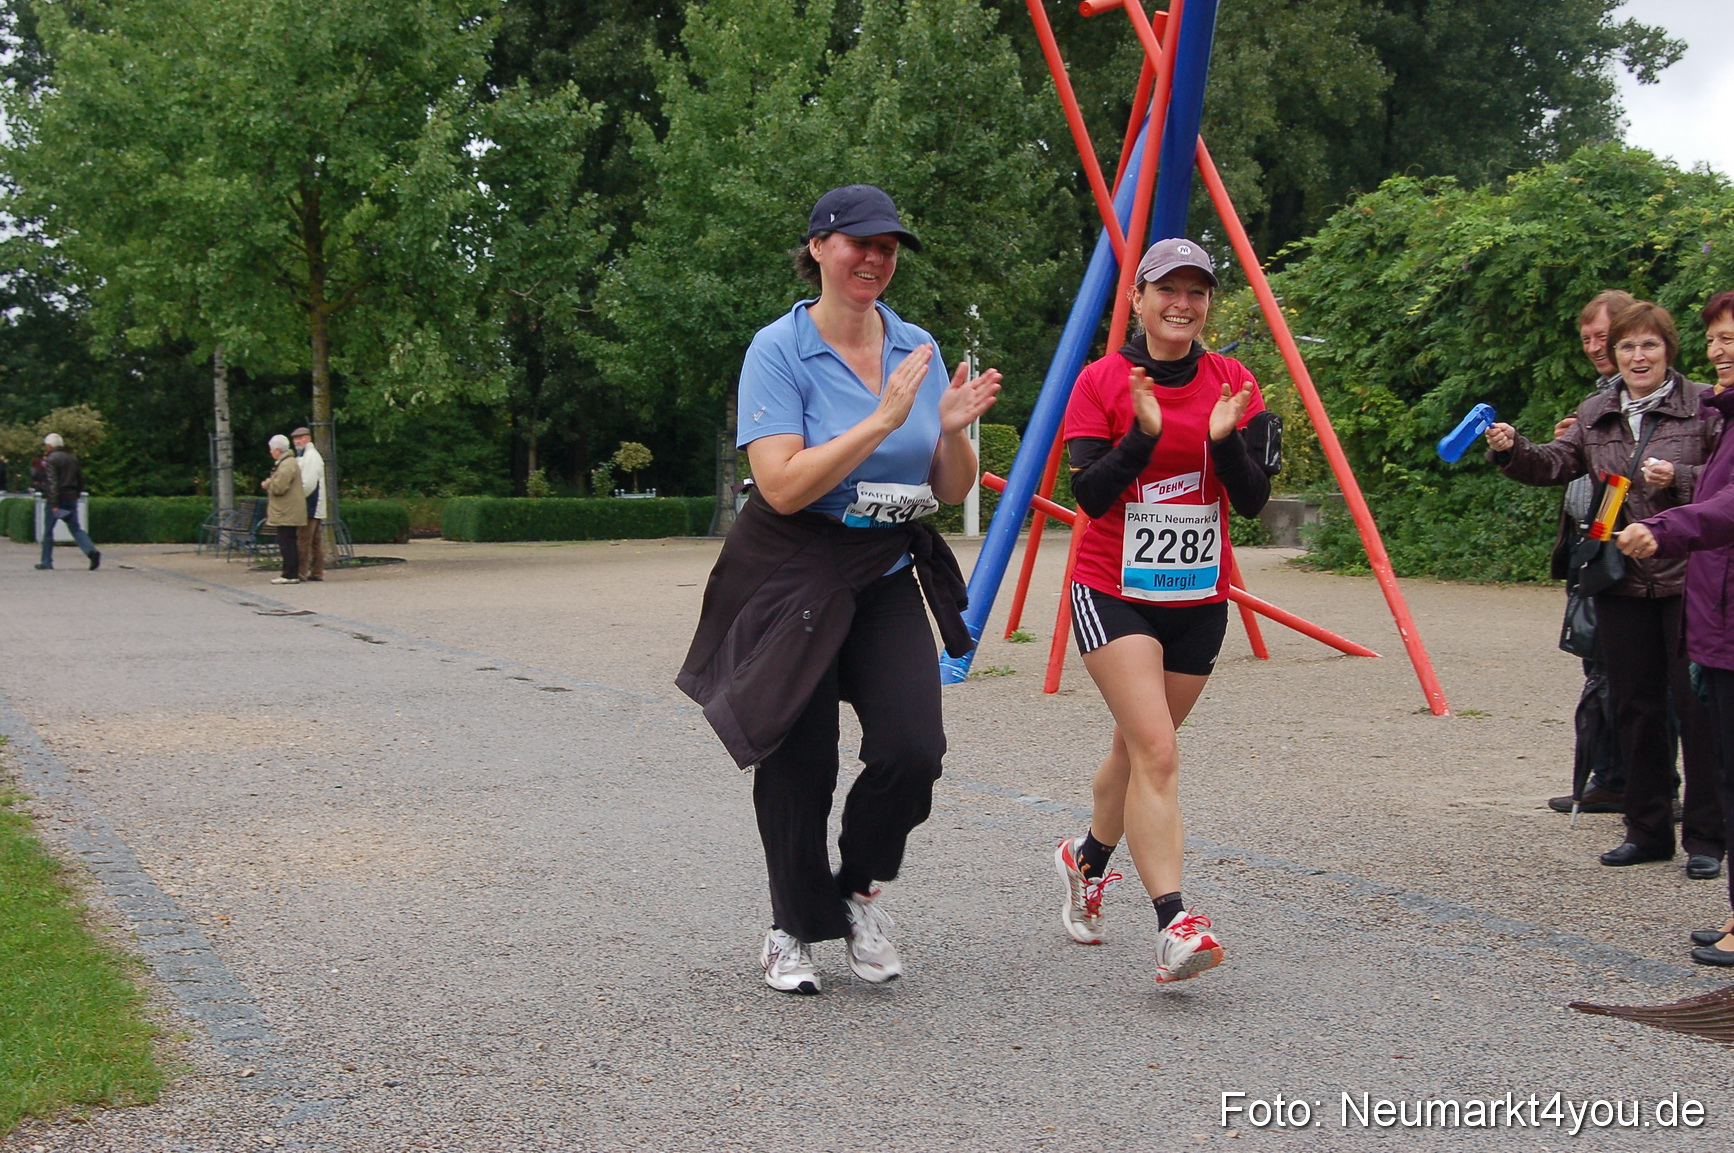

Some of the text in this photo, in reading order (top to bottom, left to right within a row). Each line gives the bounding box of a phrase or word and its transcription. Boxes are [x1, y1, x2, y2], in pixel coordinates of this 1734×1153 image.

[1159, 480, 1184, 495] DEHN
[860, 491, 897, 504] PARTL
[1127, 512, 1211, 525] PARTL Neumarkt
[1134, 528, 1215, 564] 2282
[1154, 573, 1197, 589] Margit
